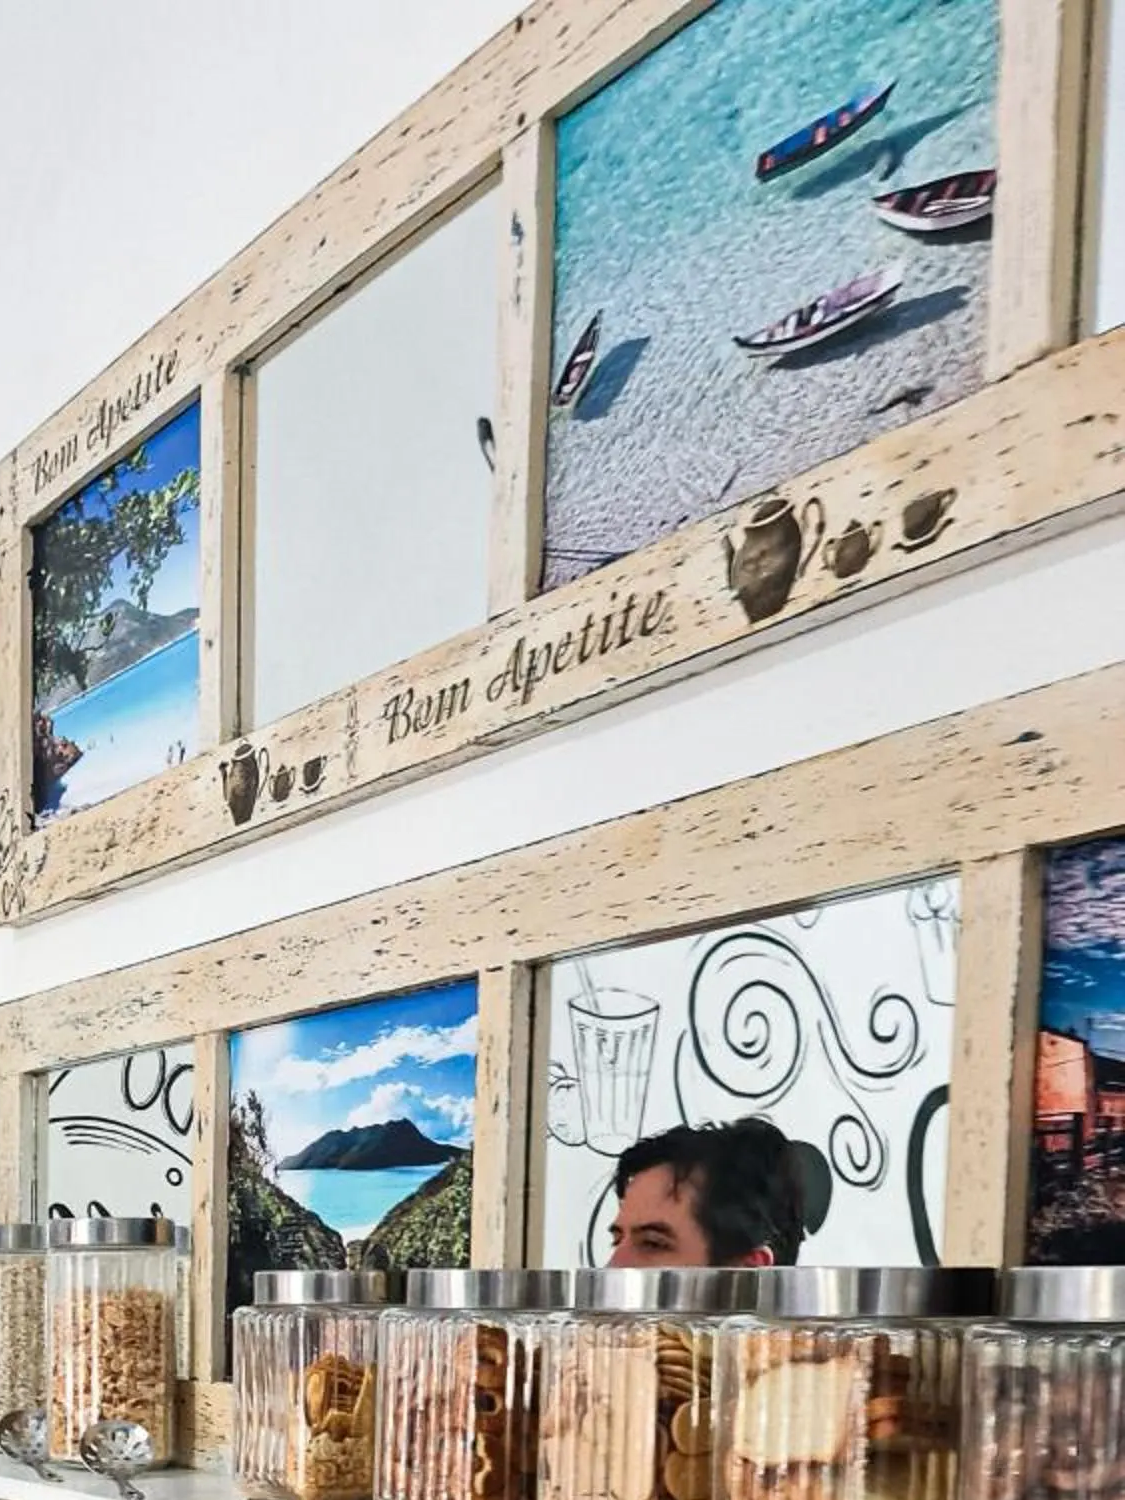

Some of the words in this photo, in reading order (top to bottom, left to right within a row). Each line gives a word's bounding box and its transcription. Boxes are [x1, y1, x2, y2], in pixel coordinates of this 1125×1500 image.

[30, 437, 78, 494] Bom
[382, 677, 471, 744] Bom
[486, 589, 667, 705] Apetite
